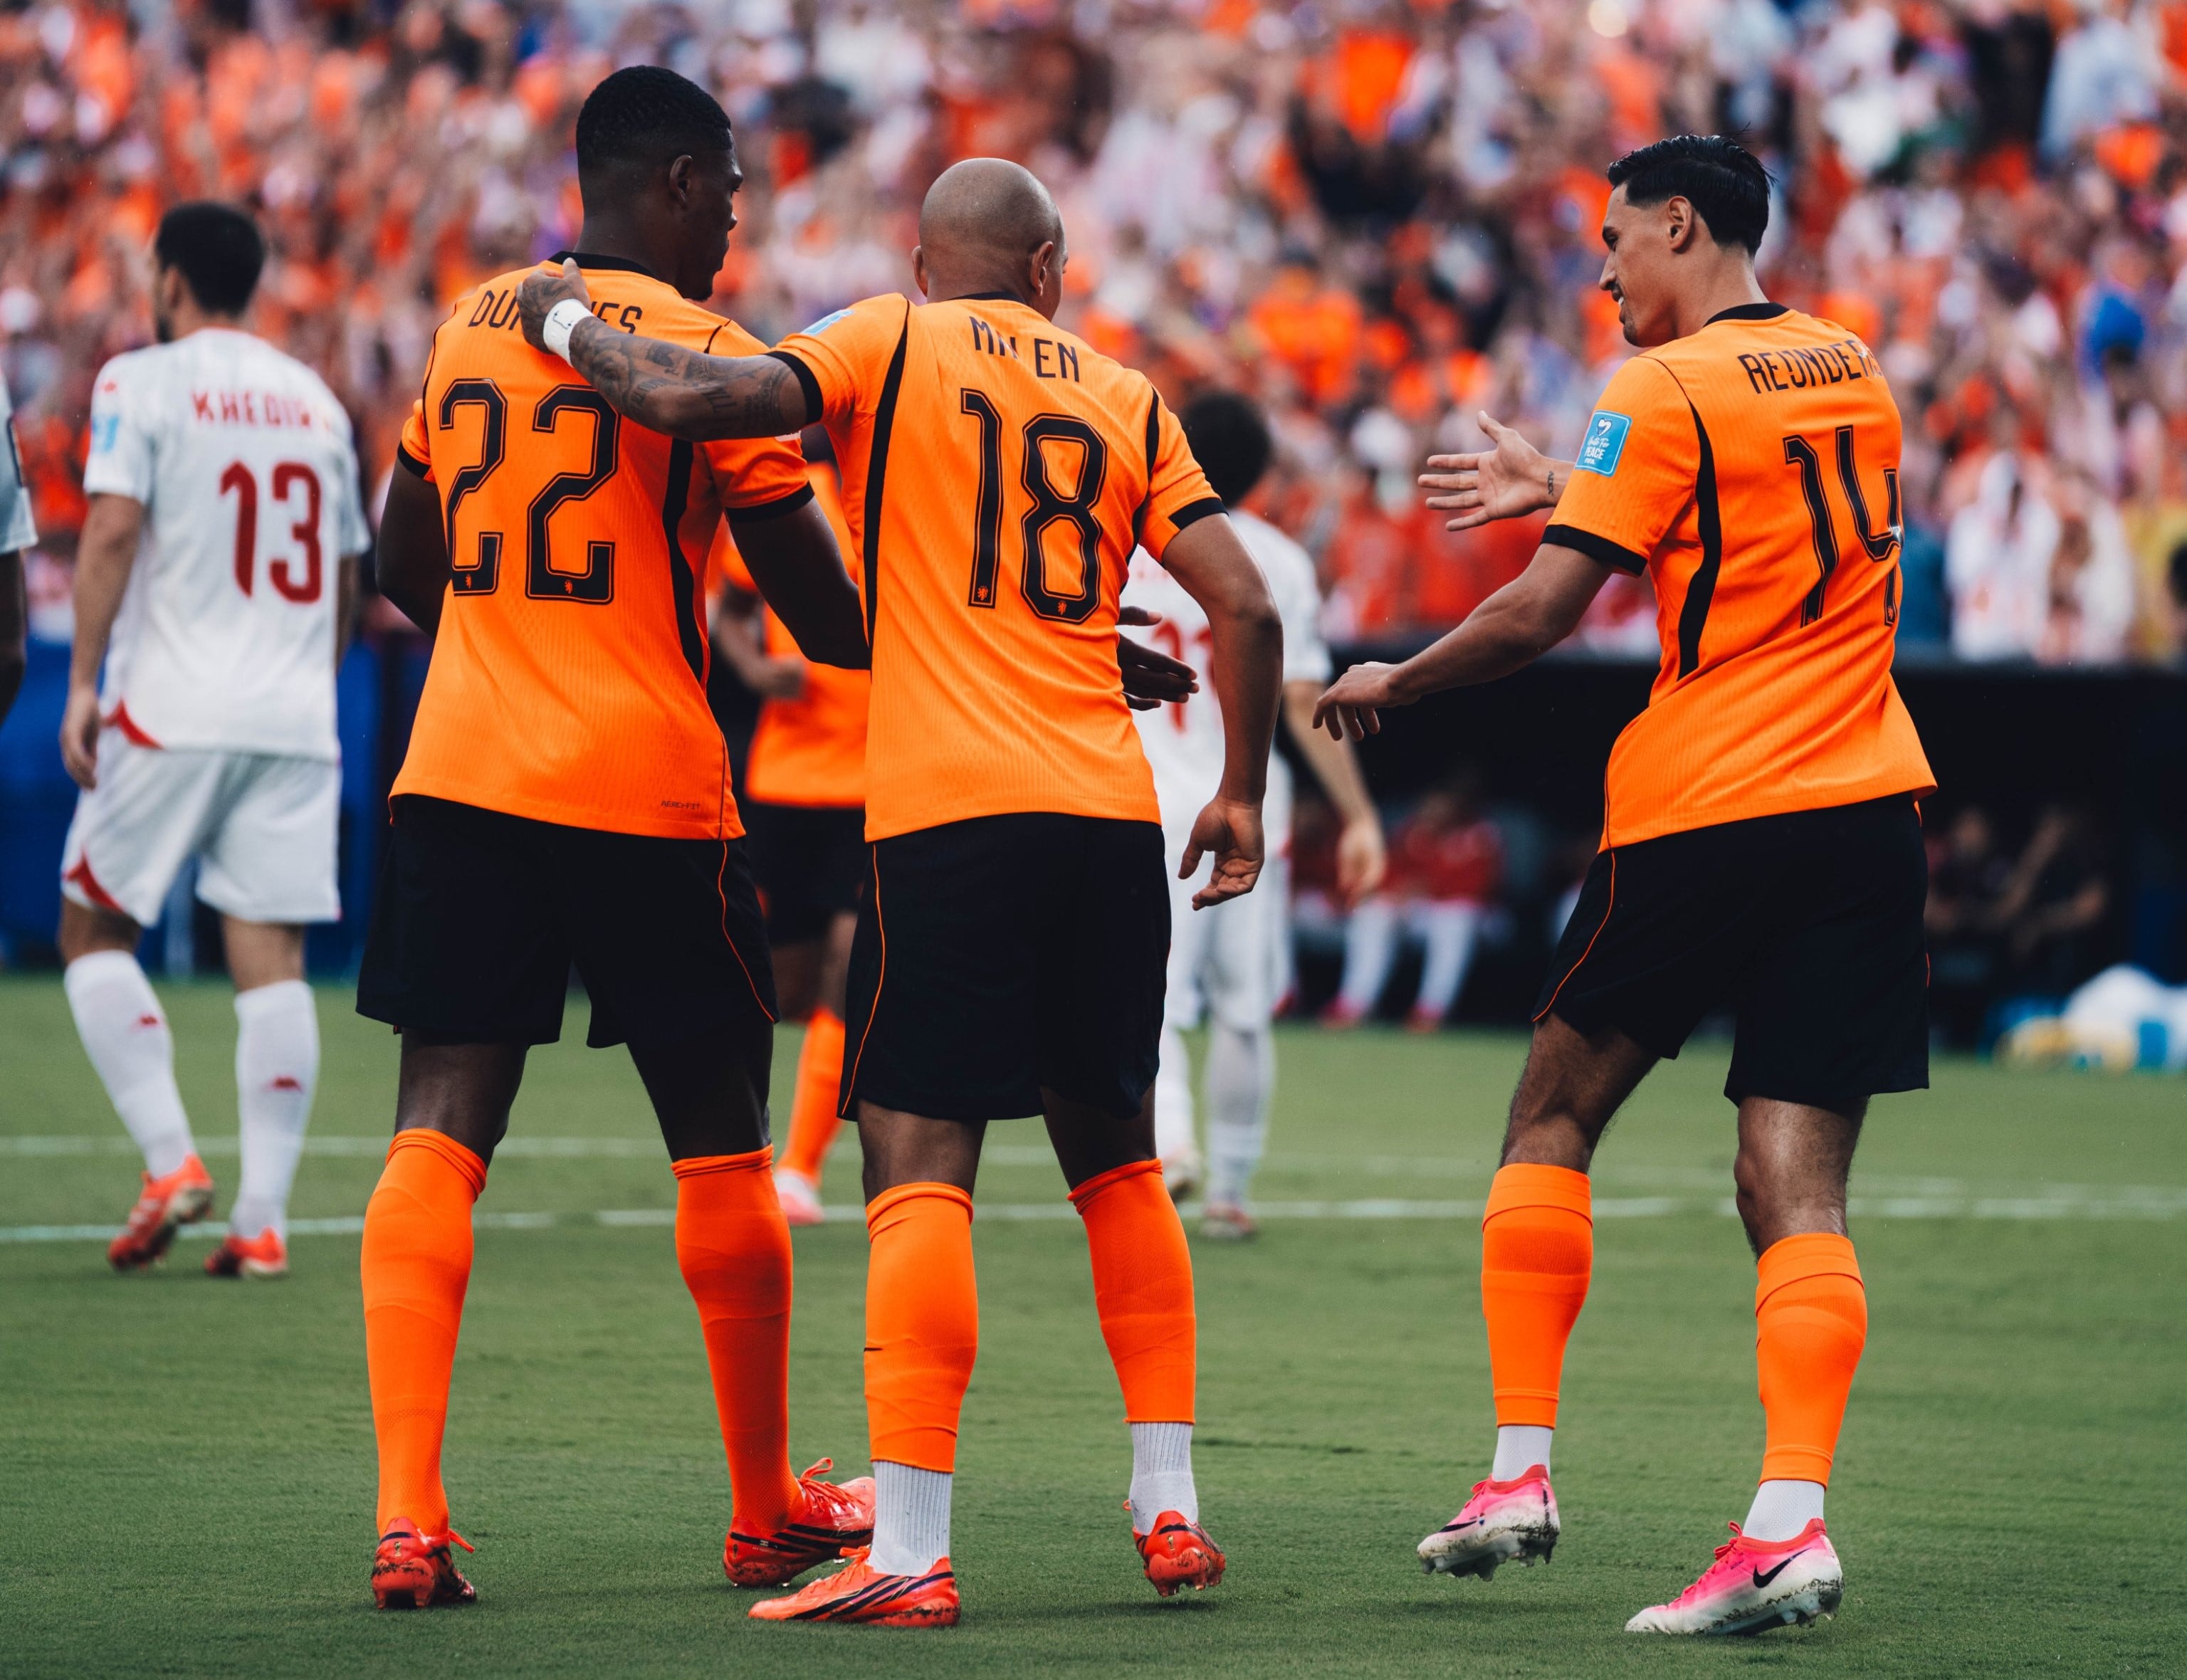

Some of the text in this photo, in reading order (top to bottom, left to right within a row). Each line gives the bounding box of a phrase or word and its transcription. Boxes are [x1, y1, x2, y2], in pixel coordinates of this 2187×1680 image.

[468, 290, 643, 335] DUES
[192, 389, 330, 429] KHEDI
[1584, 446, 1606, 460] PEACE
[220, 459, 322, 604] 13
[439, 378, 622, 604] 22
[960, 387, 1107, 624] 18
[1783, 425, 1904, 627] 14
